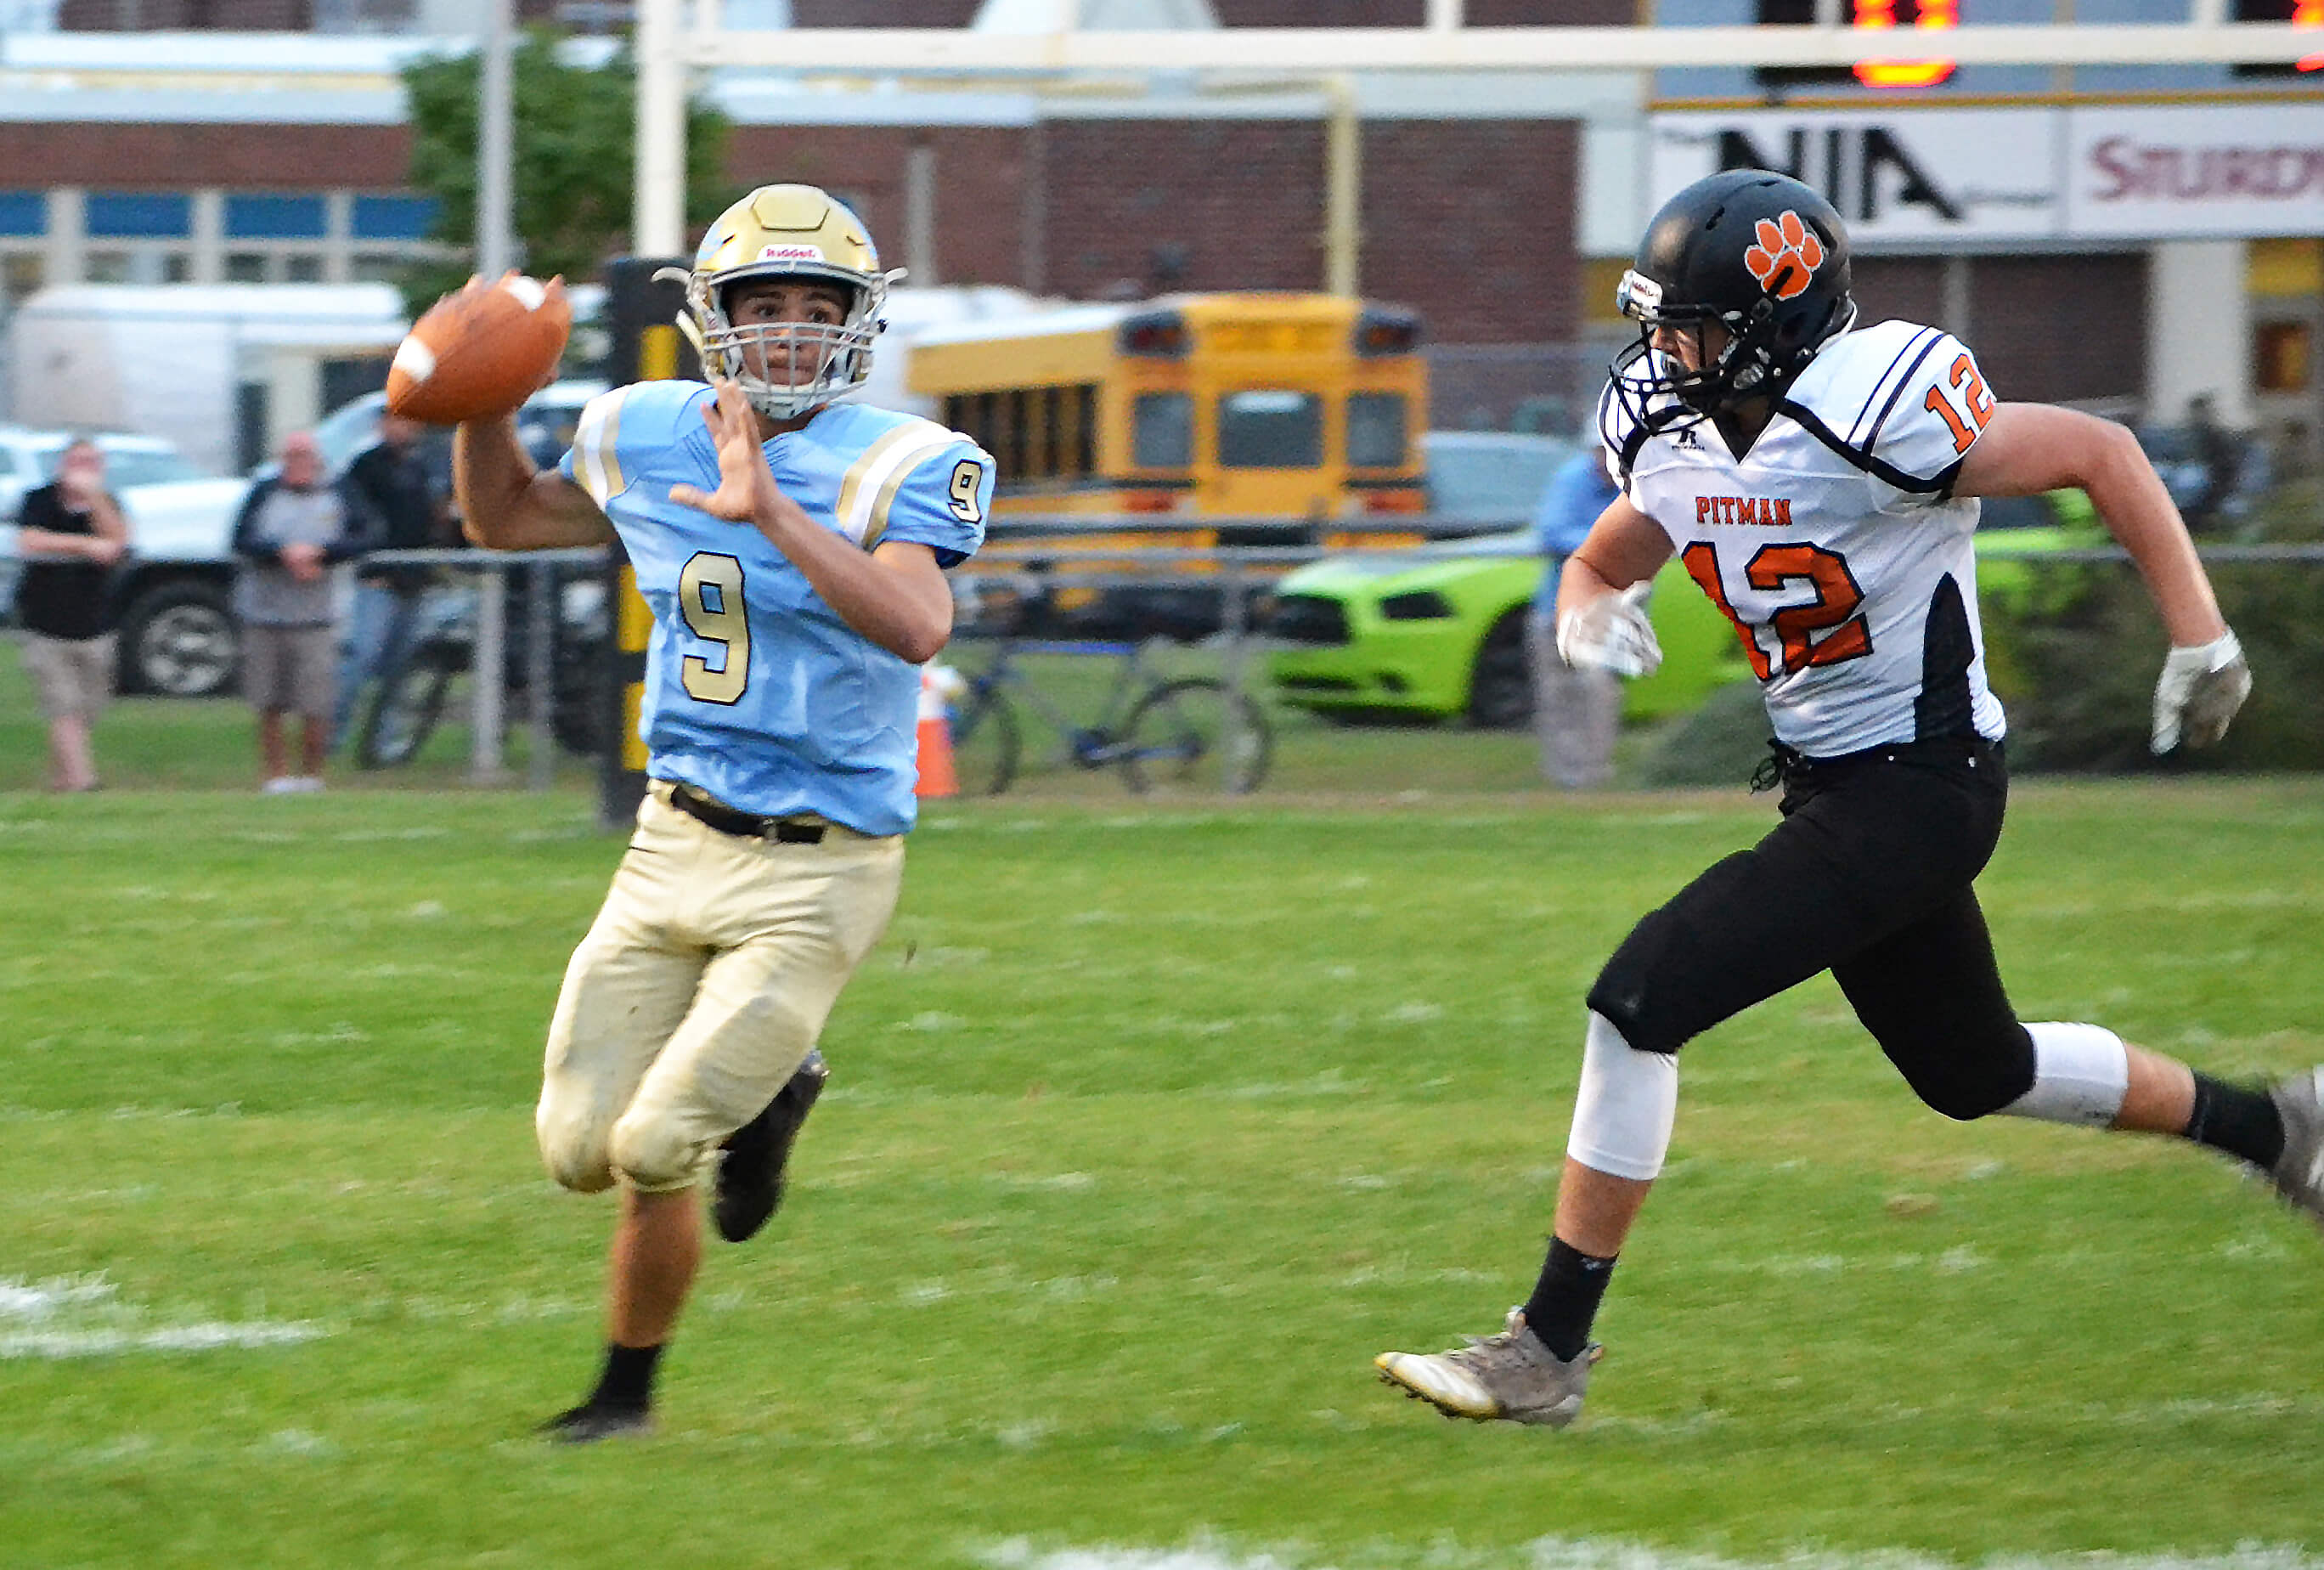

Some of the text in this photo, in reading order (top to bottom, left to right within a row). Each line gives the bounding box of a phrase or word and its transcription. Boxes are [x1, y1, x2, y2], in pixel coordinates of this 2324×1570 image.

[1925, 353, 1994, 454] 12
[948, 460, 981, 523] 9
[1695, 496, 1792, 525] PITMAN
[680, 551, 751, 705] 9
[1681, 540, 1873, 681] 12
